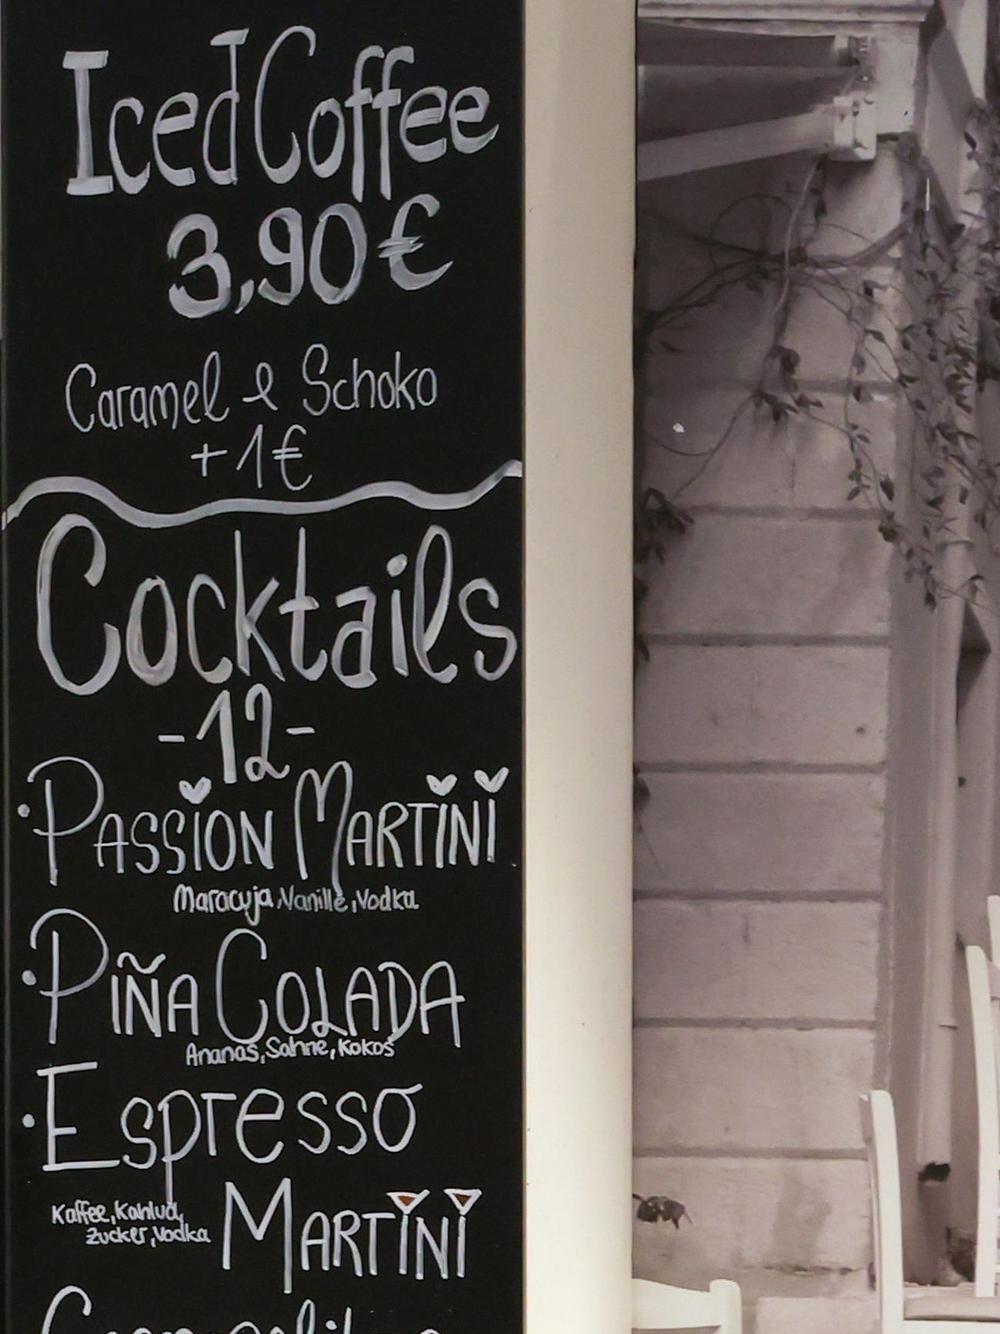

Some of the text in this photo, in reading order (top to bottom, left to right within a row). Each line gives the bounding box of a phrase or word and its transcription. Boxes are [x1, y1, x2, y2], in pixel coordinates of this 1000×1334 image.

[62, 25, 499, 202] Iced Coffee
[65, 351, 230, 433] Caramel
[302, 343, 438, 416] Schoko
[36, 513, 517, 695] Cocktails
[216, 929, 465, 1048] COLADA
[338, 1038, 394, 1058] Kokos
[37, 1062, 423, 1202] Espresso
